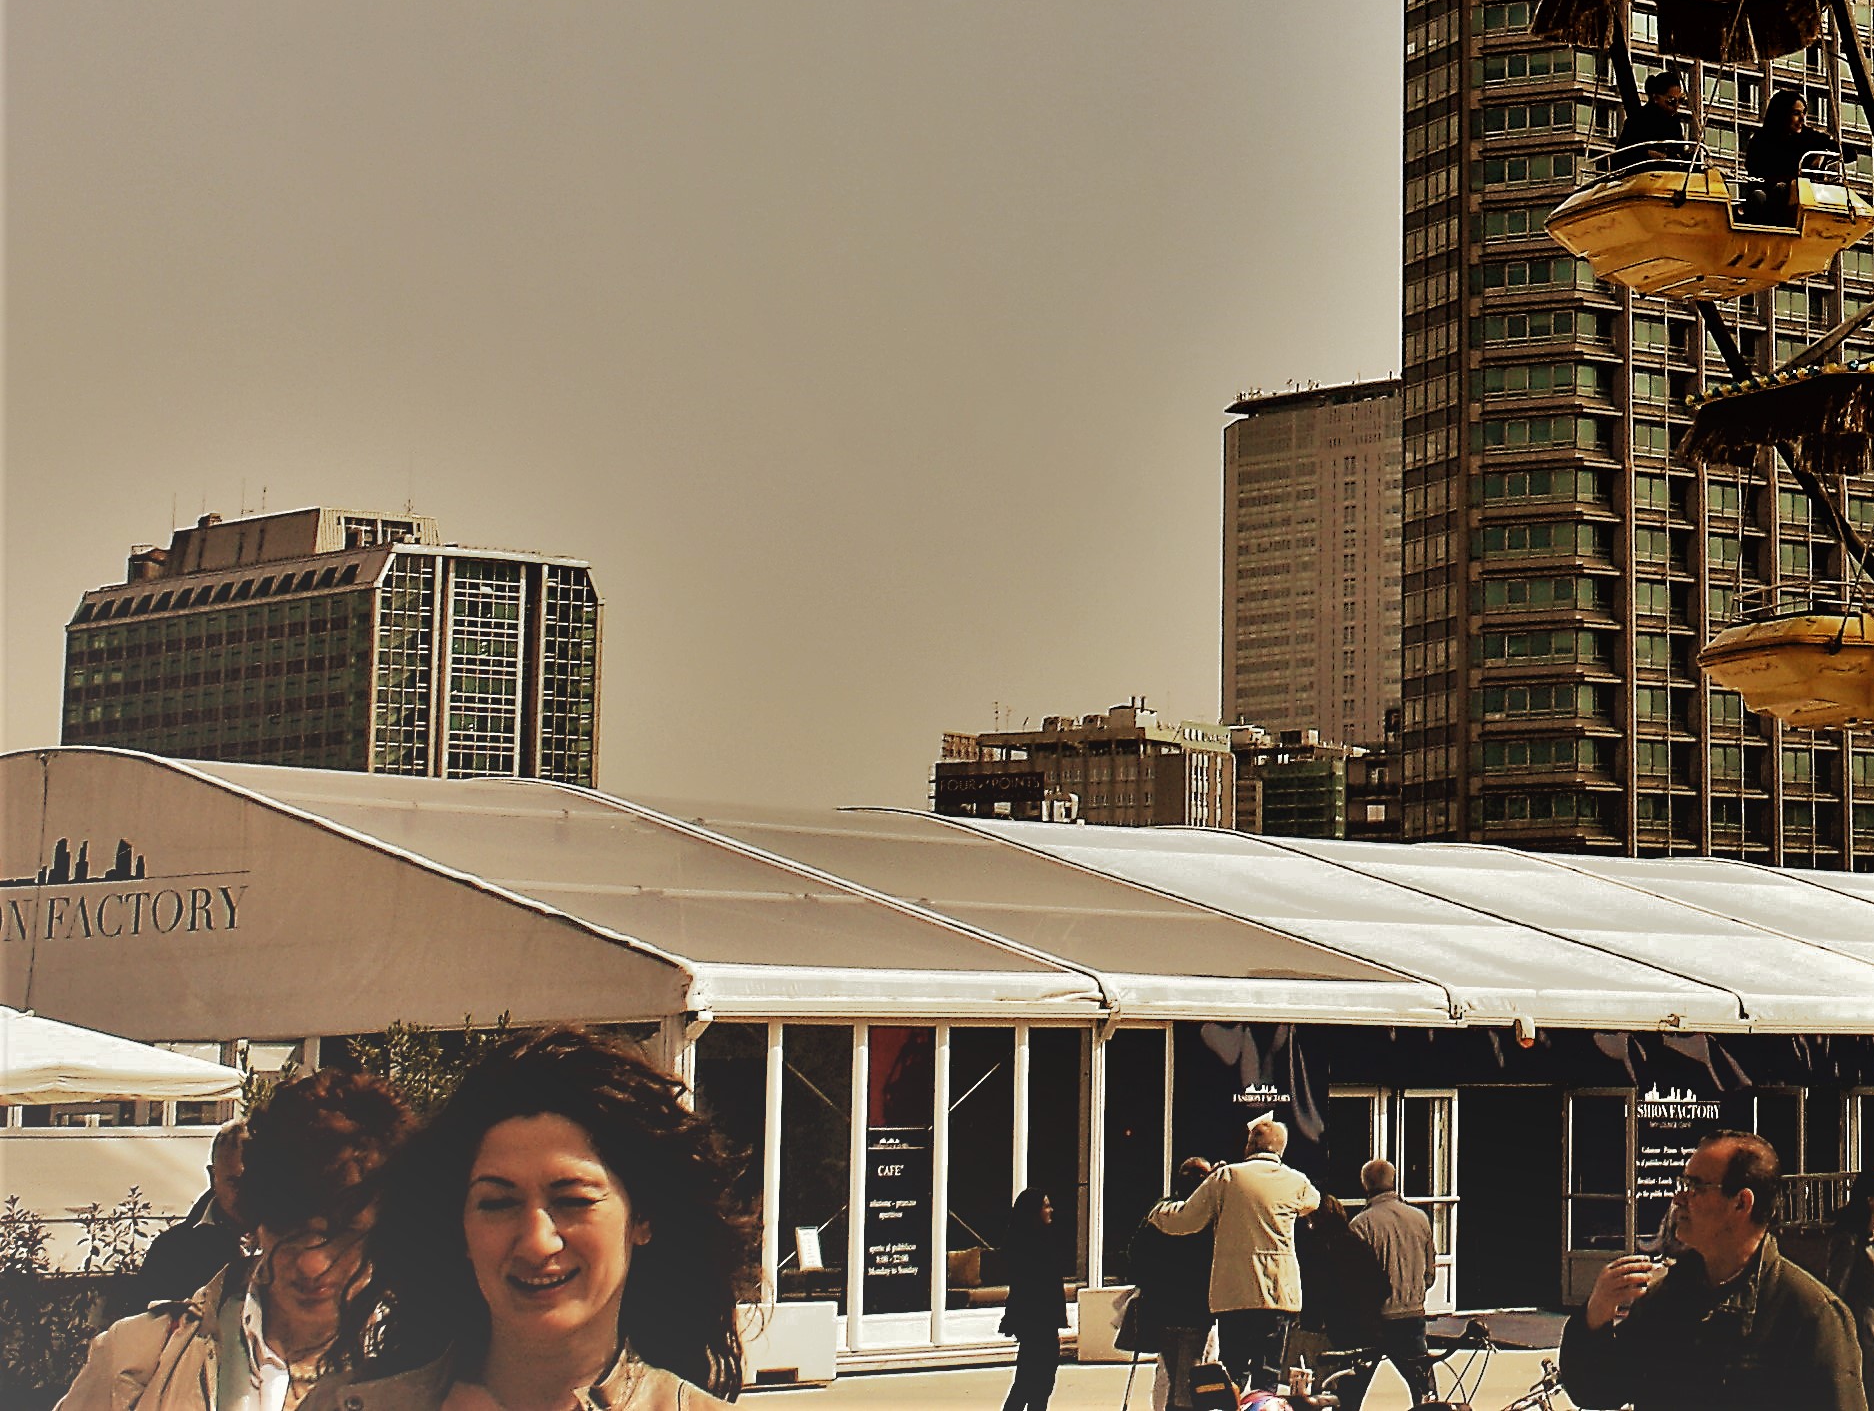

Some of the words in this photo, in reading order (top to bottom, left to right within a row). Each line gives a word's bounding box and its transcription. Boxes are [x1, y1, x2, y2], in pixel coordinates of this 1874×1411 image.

[45, 885, 249, 940] FACTORY
[1624, 1103, 1668, 1118] SHION
[1669, 1103, 1720, 1119] FACTORY
